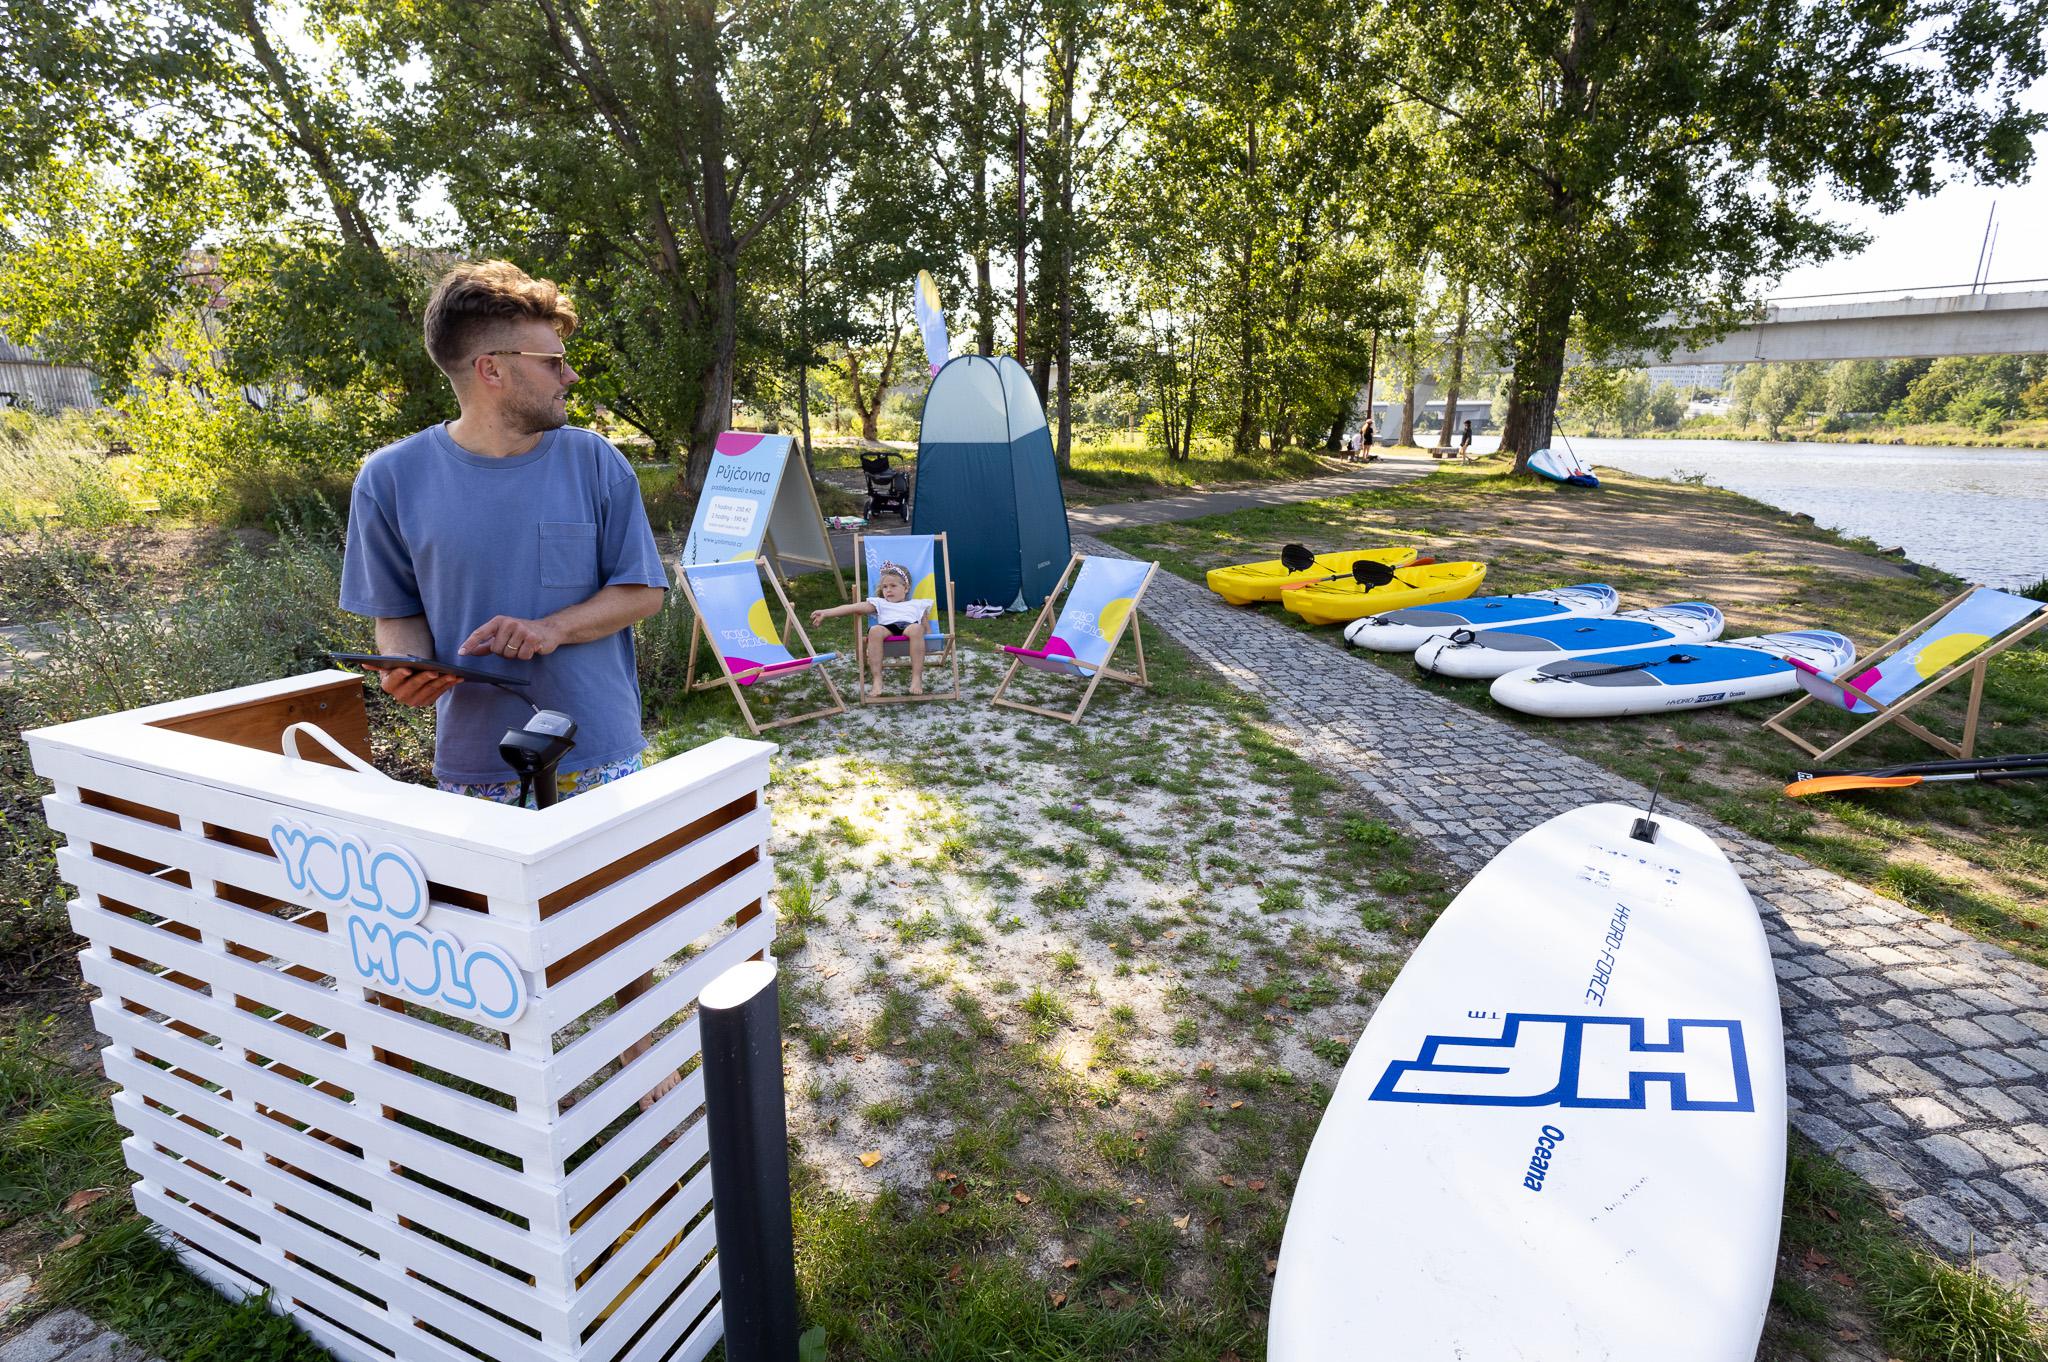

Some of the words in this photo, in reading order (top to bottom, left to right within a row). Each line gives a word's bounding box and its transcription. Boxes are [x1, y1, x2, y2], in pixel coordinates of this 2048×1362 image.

[715, 464, 770, 483] Půjčovna
[721, 629, 750, 640] YOLO
[737, 637, 768, 648] MOLO
[272, 824, 421, 919] YOLO
[349, 915, 518, 1019] MOLO
[1586, 902, 1631, 1007] HYDRO-FORCE
[1523, 1125, 1565, 1192] Oceana
